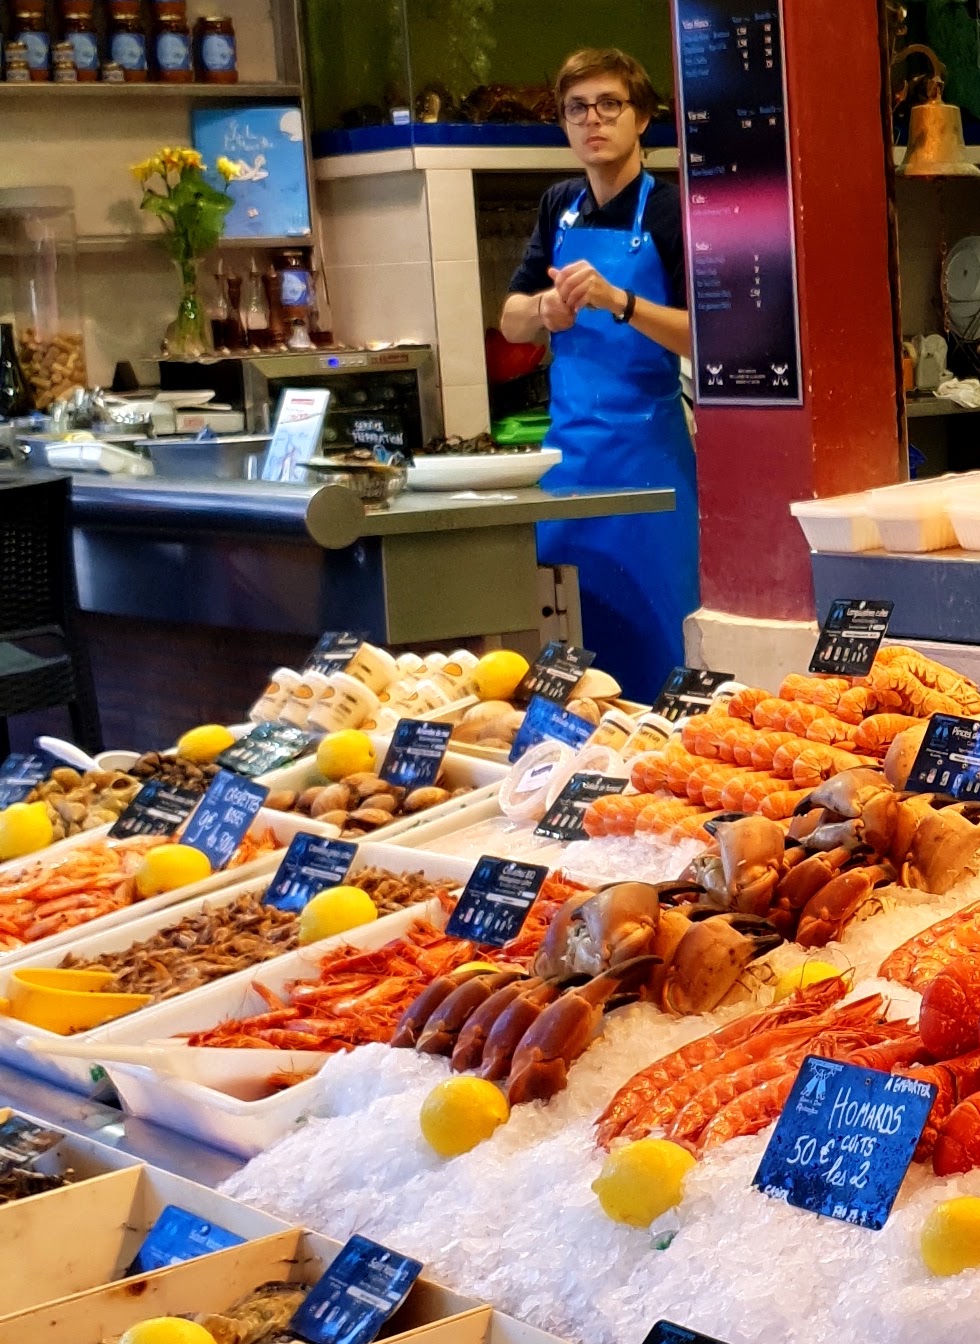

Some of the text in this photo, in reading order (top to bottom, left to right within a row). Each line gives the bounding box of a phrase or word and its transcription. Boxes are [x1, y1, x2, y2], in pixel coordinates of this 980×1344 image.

[786, 1134, 835, 1166] 50 €
[821, 1156, 871, 1189] les 2
